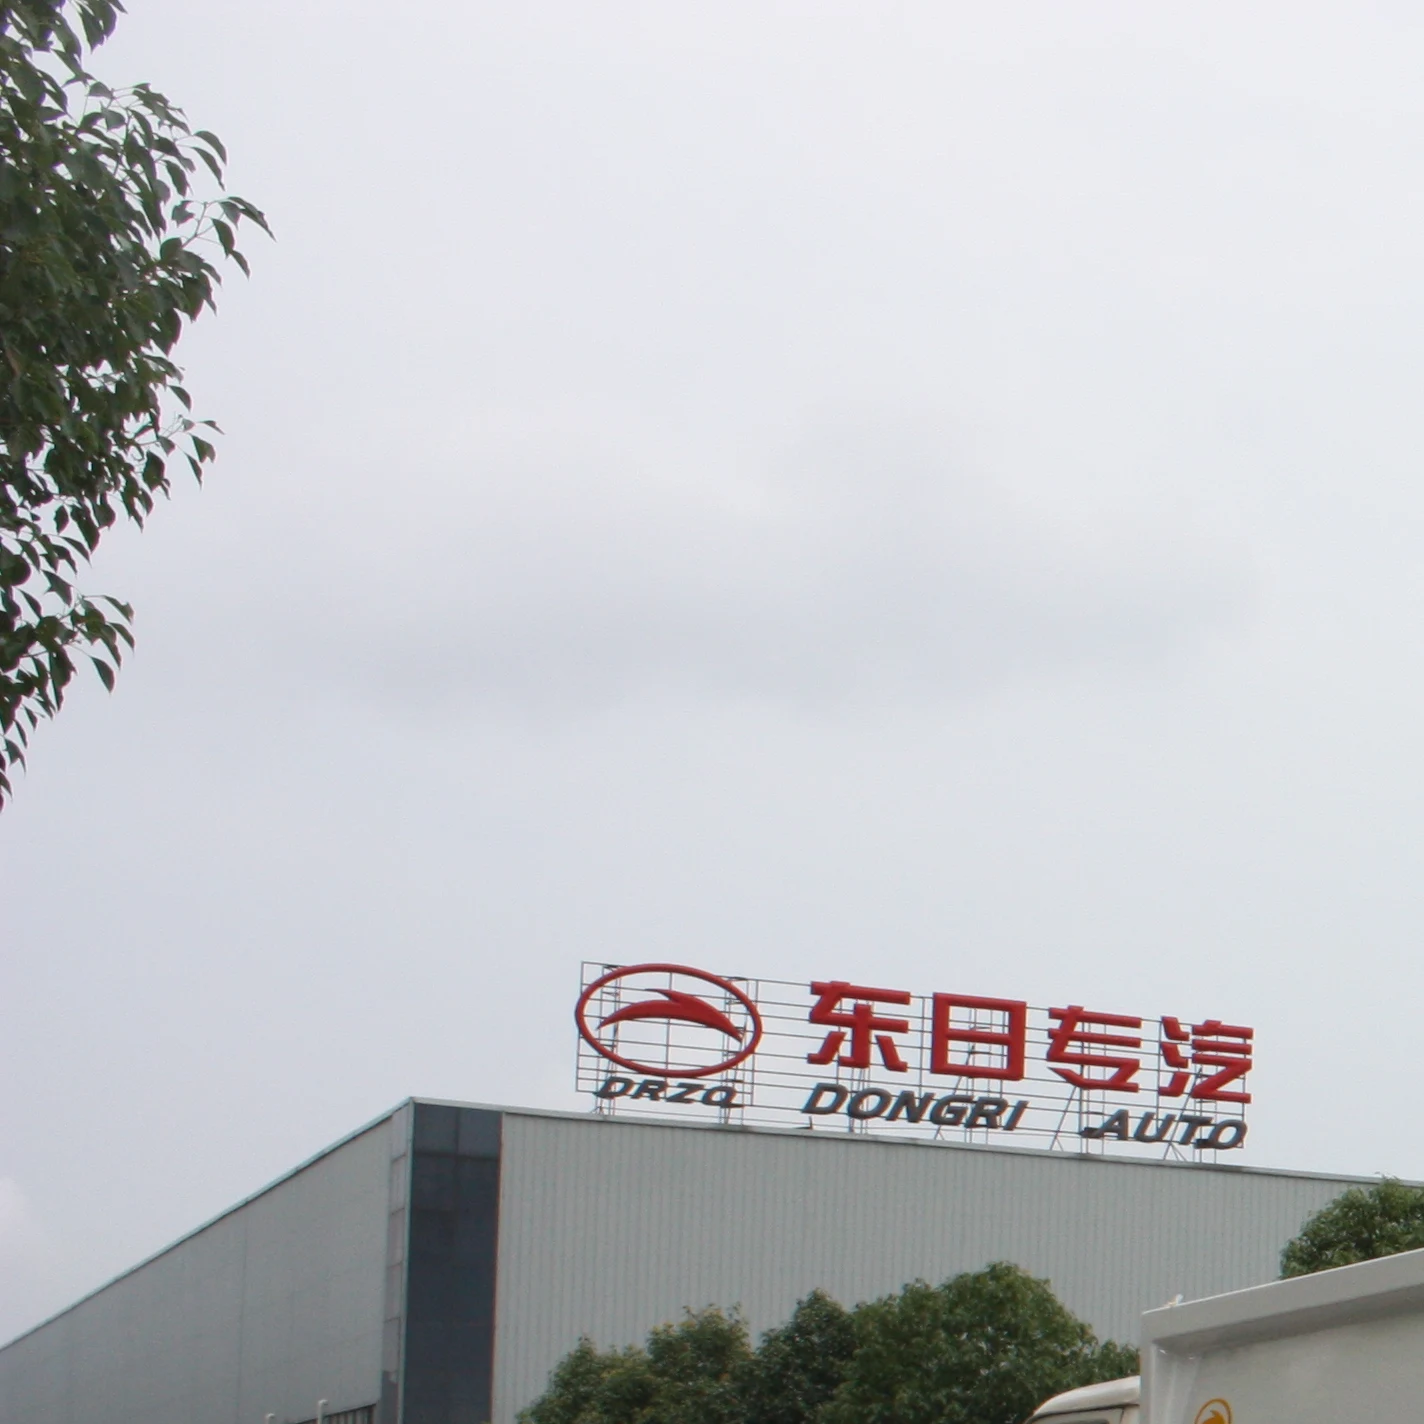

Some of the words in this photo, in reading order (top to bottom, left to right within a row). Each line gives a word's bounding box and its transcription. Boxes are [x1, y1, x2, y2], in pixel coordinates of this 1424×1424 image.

[806, 981, 1254, 1103] 东日专汽
[595, 1077, 745, 1108] DRZQ
[801, 1082, 1029, 1131] DONGRI
[1080, 1109, 1248, 1150] AUTO
